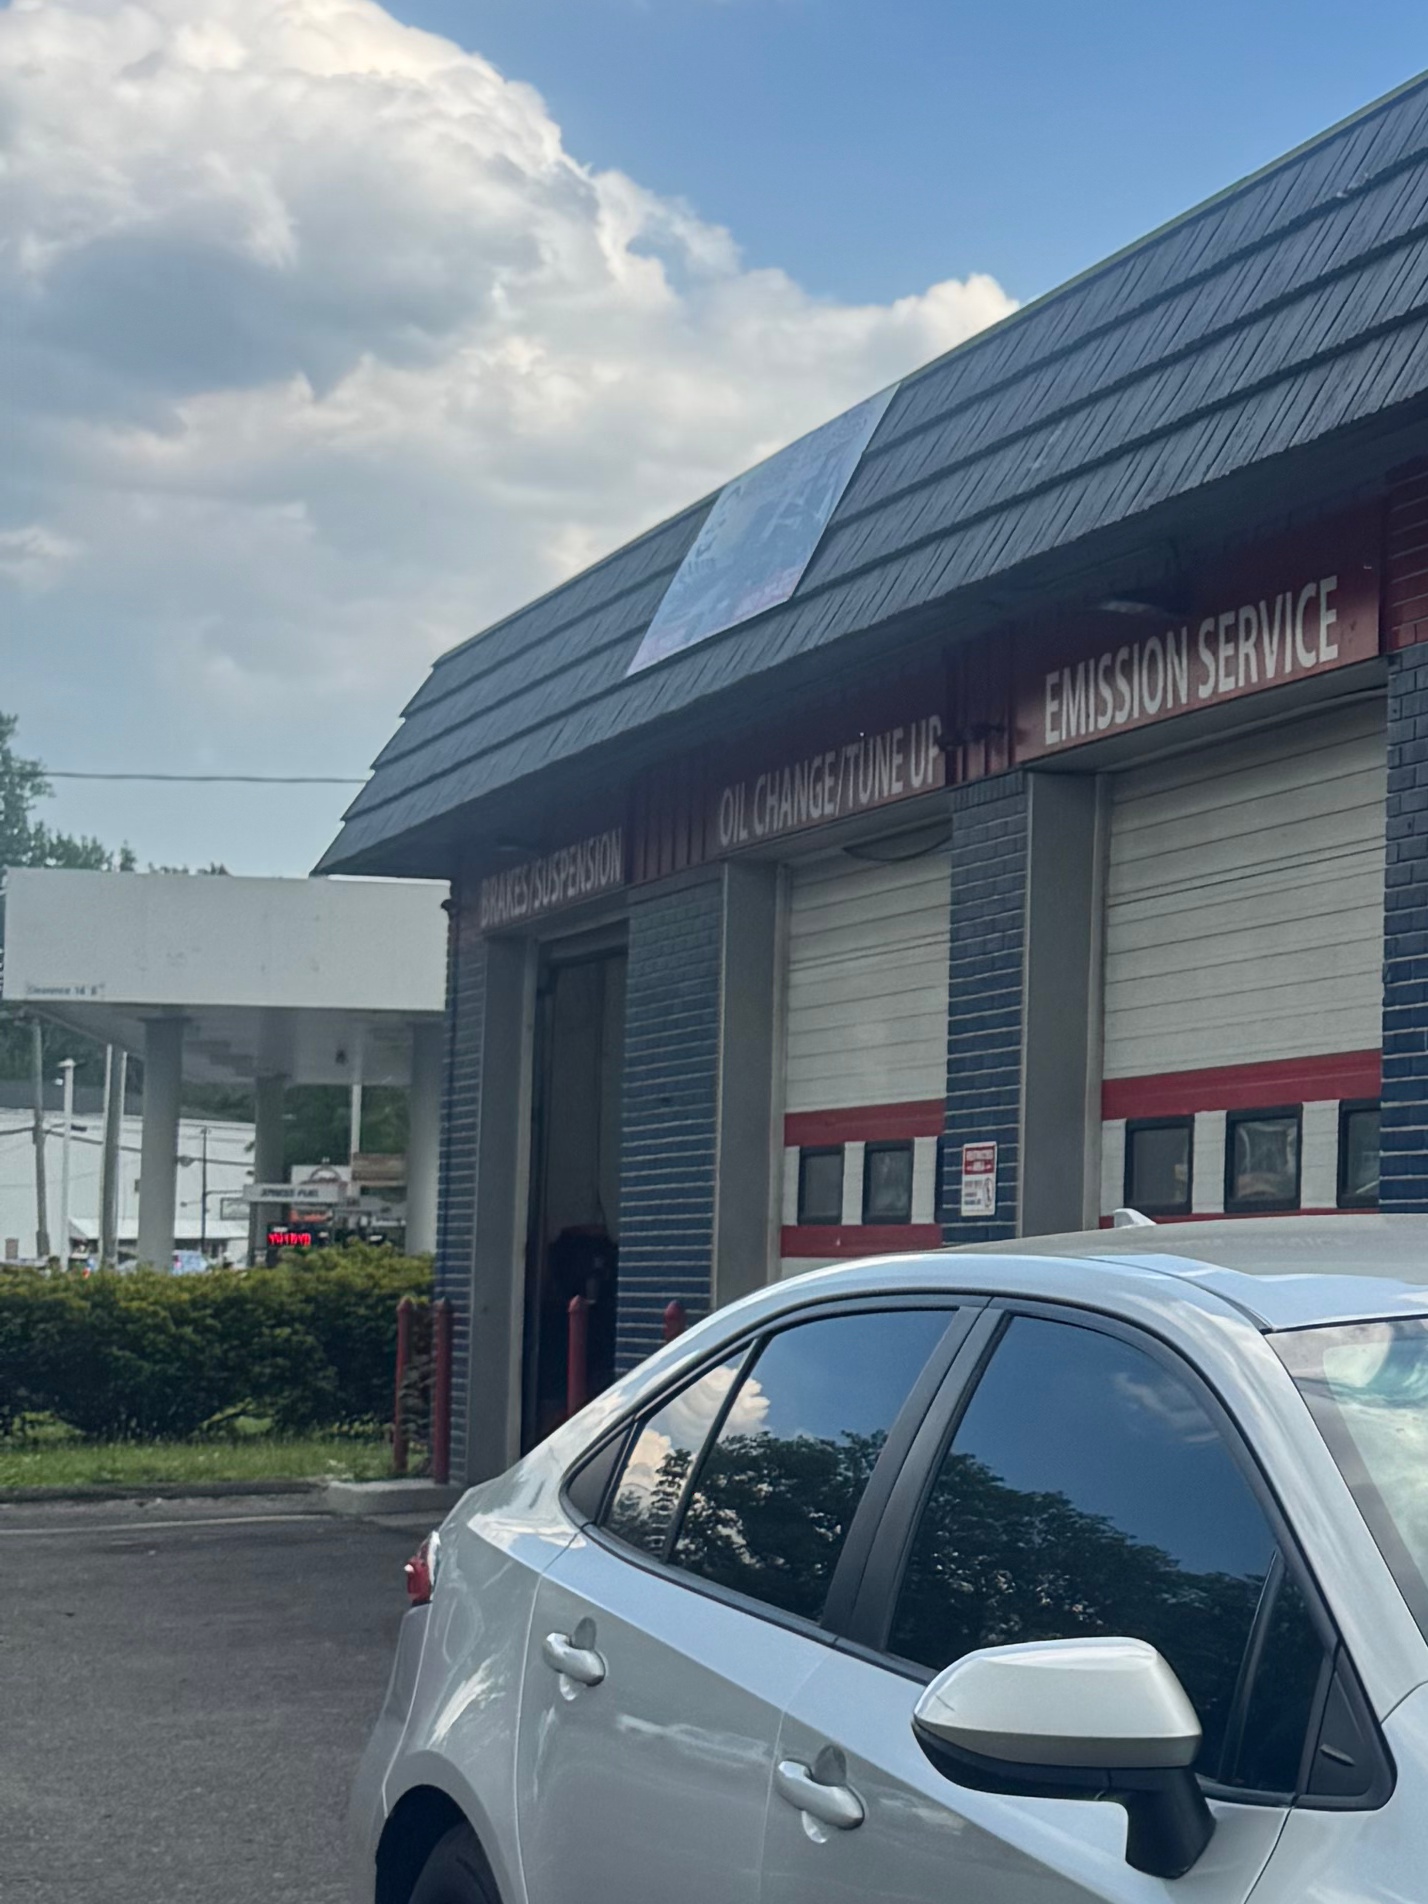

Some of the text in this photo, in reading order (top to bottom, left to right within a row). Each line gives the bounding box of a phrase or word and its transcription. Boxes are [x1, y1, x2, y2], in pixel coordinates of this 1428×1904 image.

[1044, 574, 1339, 746] EMISSION SERVICE
[717, 786, 749, 847] OIL
[909, 714, 943, 788] UP
